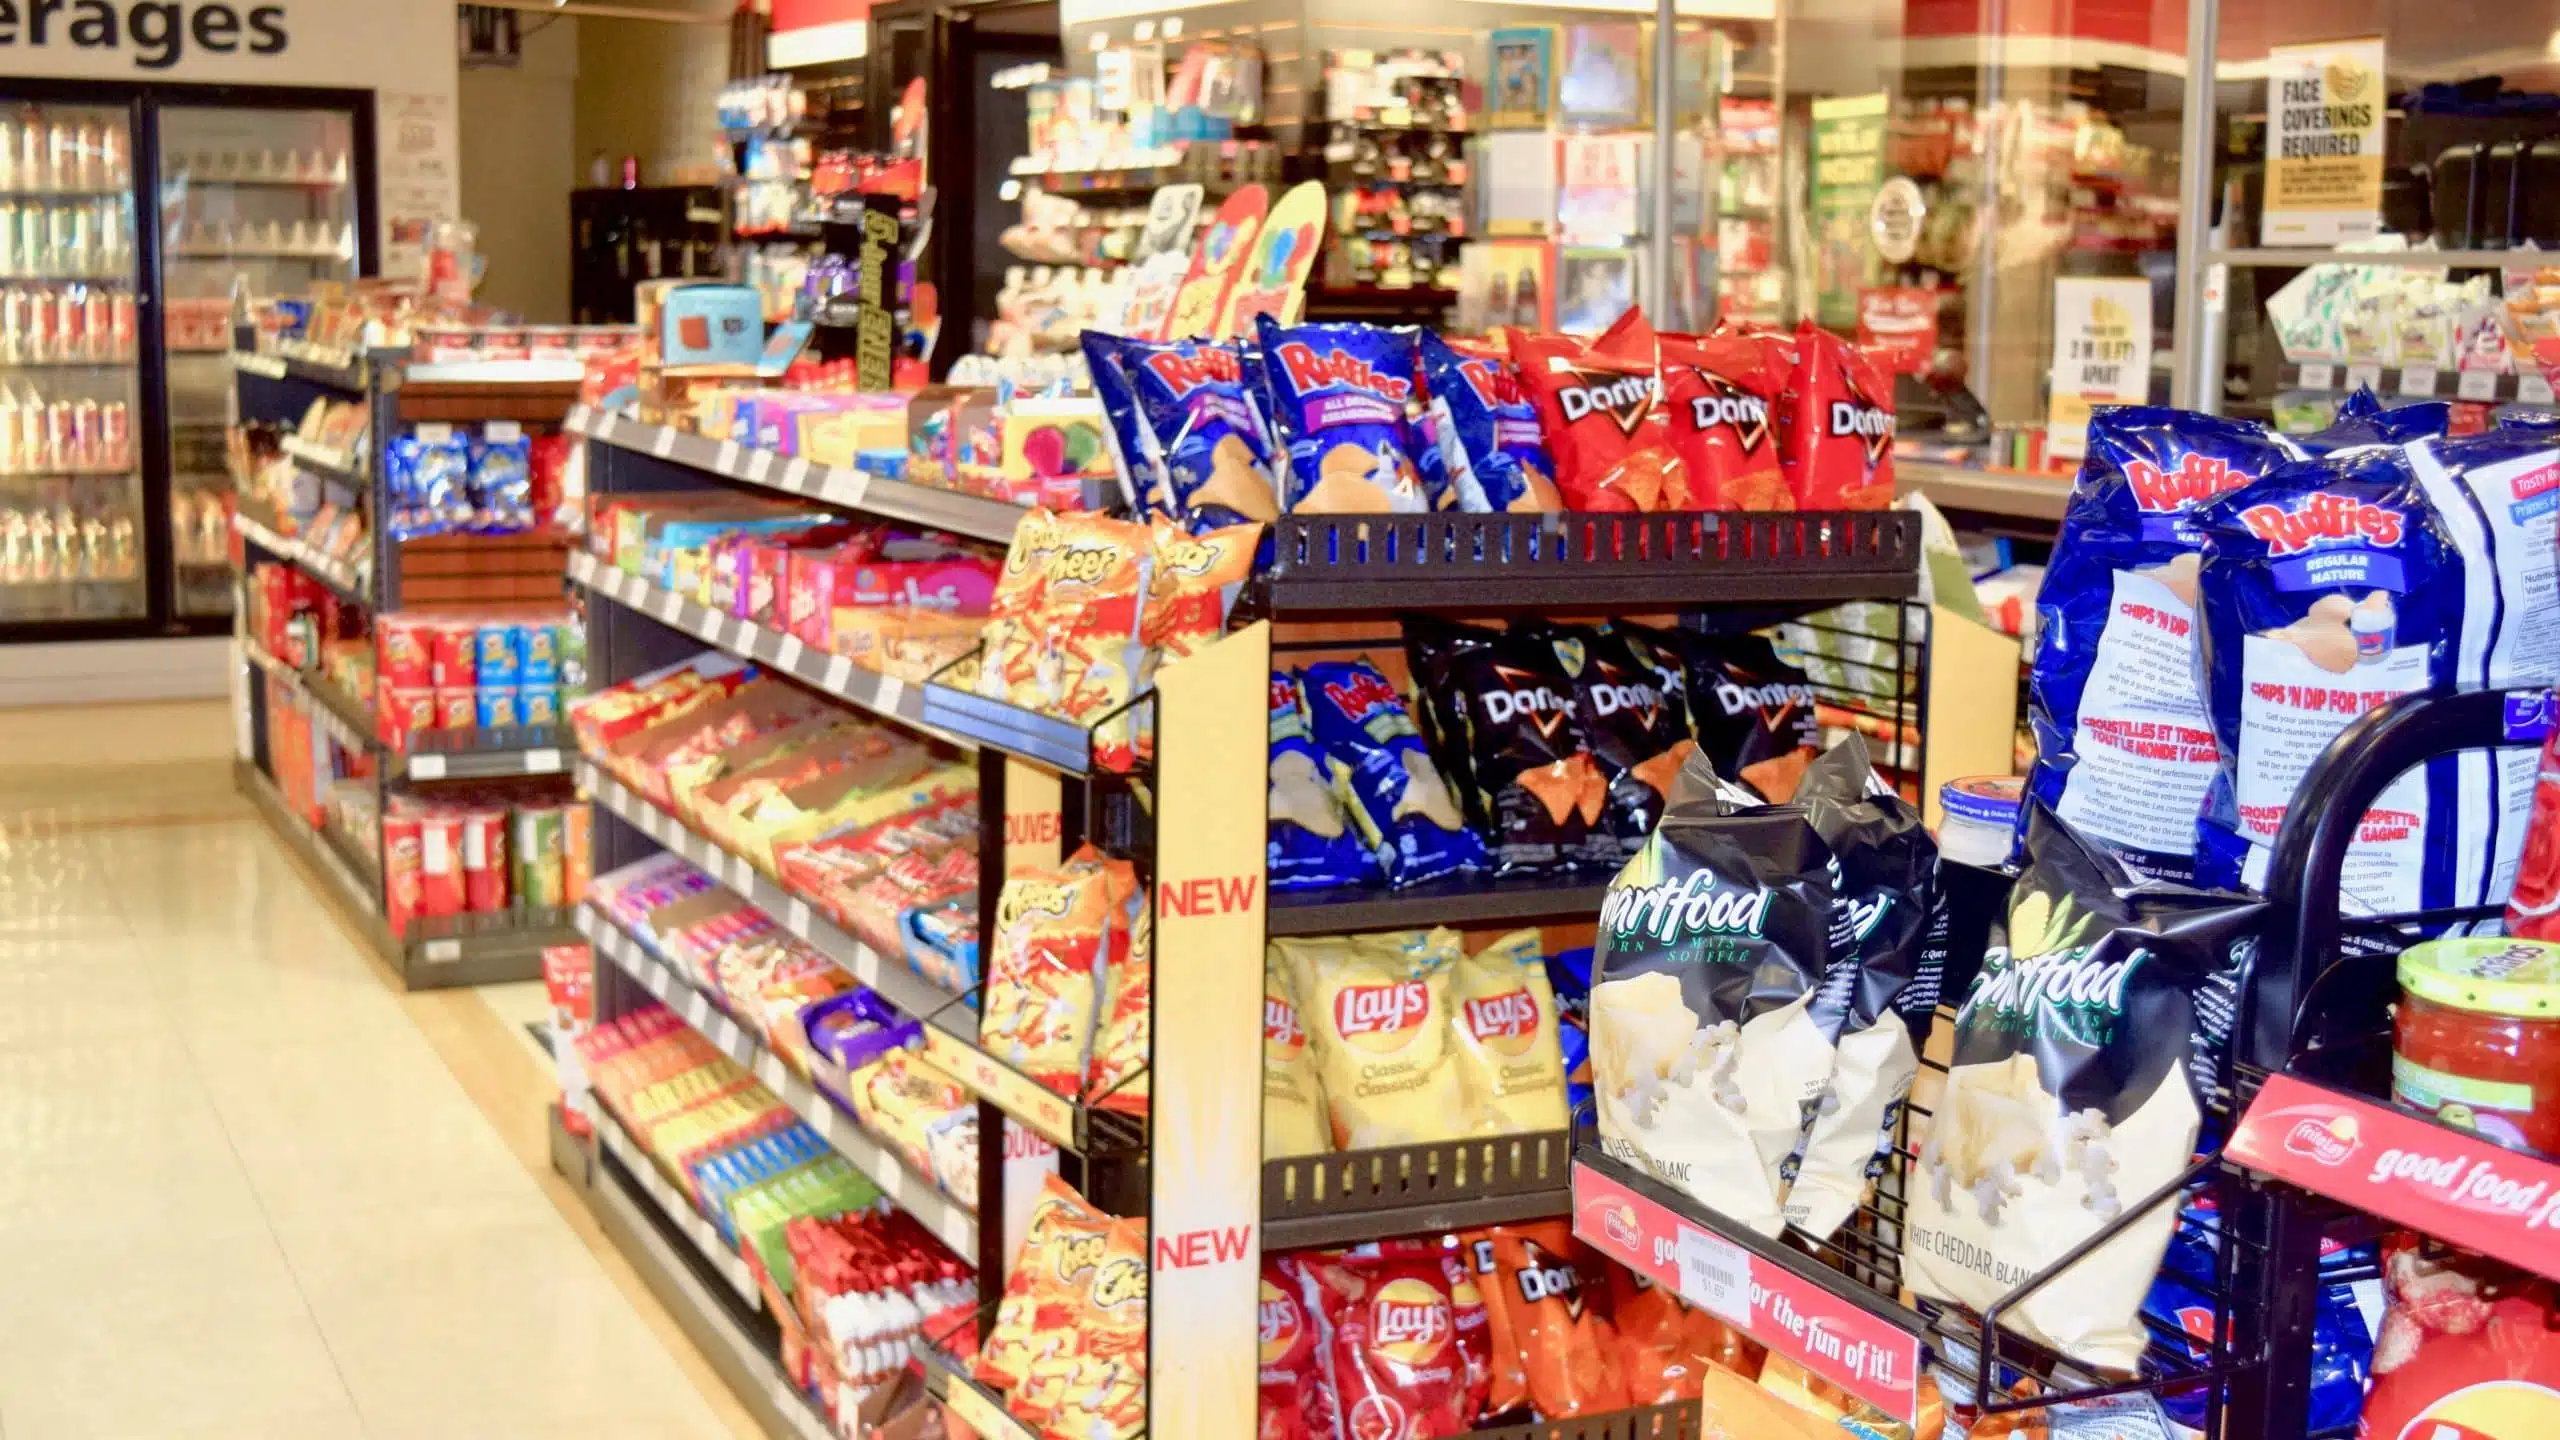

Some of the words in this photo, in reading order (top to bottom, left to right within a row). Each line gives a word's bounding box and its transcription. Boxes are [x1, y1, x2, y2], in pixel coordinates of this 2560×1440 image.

[2282, 79, 2320, 103] FACE
[2282, 104, 2372, 131] COVERINGS
[2282, 132, 2361, 162] REQUIRED
[1274, 342, 1413, 401] Ruffles
[2237, 491, 2405, 558] Ruffles
[2306, 555, 2369, 572] REGULAR
[2311, 568, 2367, 584] NATURE
[2119, 601, 2155, 624] CHIPS
[2170, 614, 2190, 637] DIP
[2250, 682, 2286, 704] CHIPS
[2303, 687, 2326, 711] DIP
[2329, 689, 2358, 715] FOR
[2081, 716, 2156, 740] CROUSTILLES
[2157, 724, 2173, 743] ET
[2090, 728, 2118, 748] TOUT
[2121, 738, 2134, 754] LE
[2136, 739, 2178, 761] MONDE
[1160, 875, 1257, 919] NEW
[1340, 981, 1426, 1033] Lay's
[1467, 990, 1535, 1040] Lay's
[2368, 1149, 2466, 1187] good
[2450, 1161, 2548, 1213] food
[1155, 1224, 1252, 1272] NEW
[1934, 1230, 1994, 1278] CHEDDAR
[1996, 1260, 2034, 1288] BLAN
[1377, 1302, 1446, 1343] Lay's
[1749, 1271, 1771, 1310] or
[1773, 1294, 1805, 1337] the
[1805, 1319, 1841, 1361] fun
[1845, 1340, 1868, 1380] of
[1869, 1344, 1894, 1383] it!
